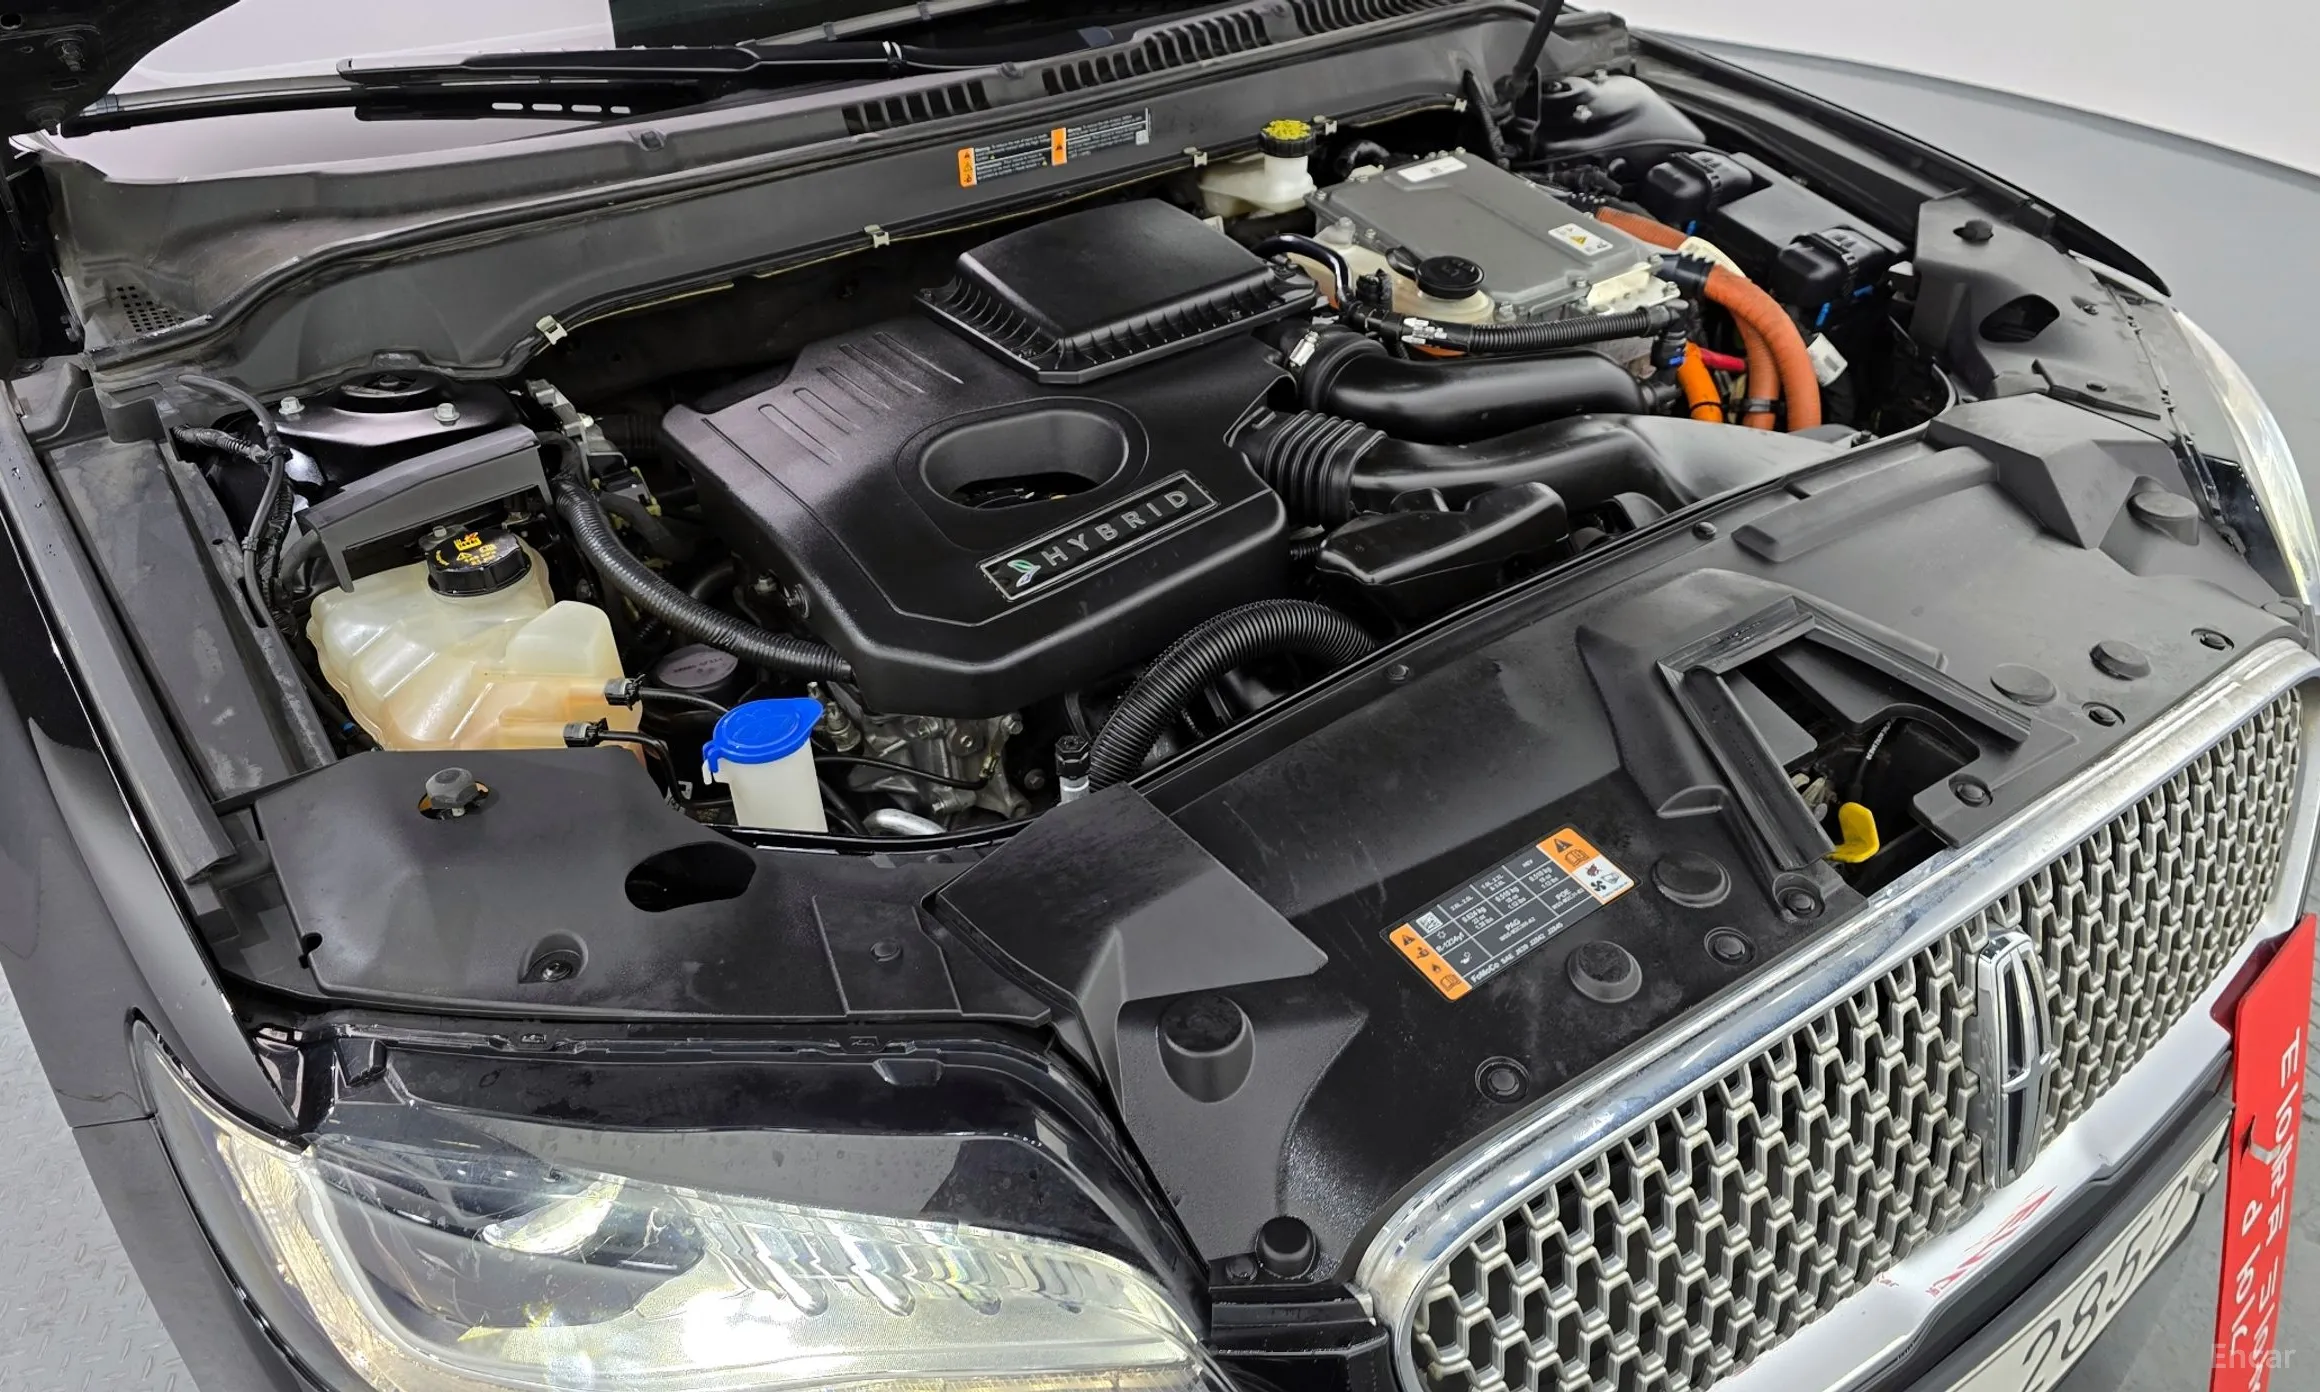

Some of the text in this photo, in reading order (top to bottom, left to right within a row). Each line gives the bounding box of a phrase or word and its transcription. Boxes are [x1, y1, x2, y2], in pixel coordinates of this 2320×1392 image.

[1041, 490, 1189, 567] HYBRID
[1470, 962, 1500, 983] FoMoCo
[1500, 953, 1515, 964] SAE
[1504, 918, 1520, 931] PAG
[2265, 1026, 2300, 1247] 브레이크
[2021, 1176, 2189, 1392] 2852
[2231, 1199, 2263, 1357] 기어 P
